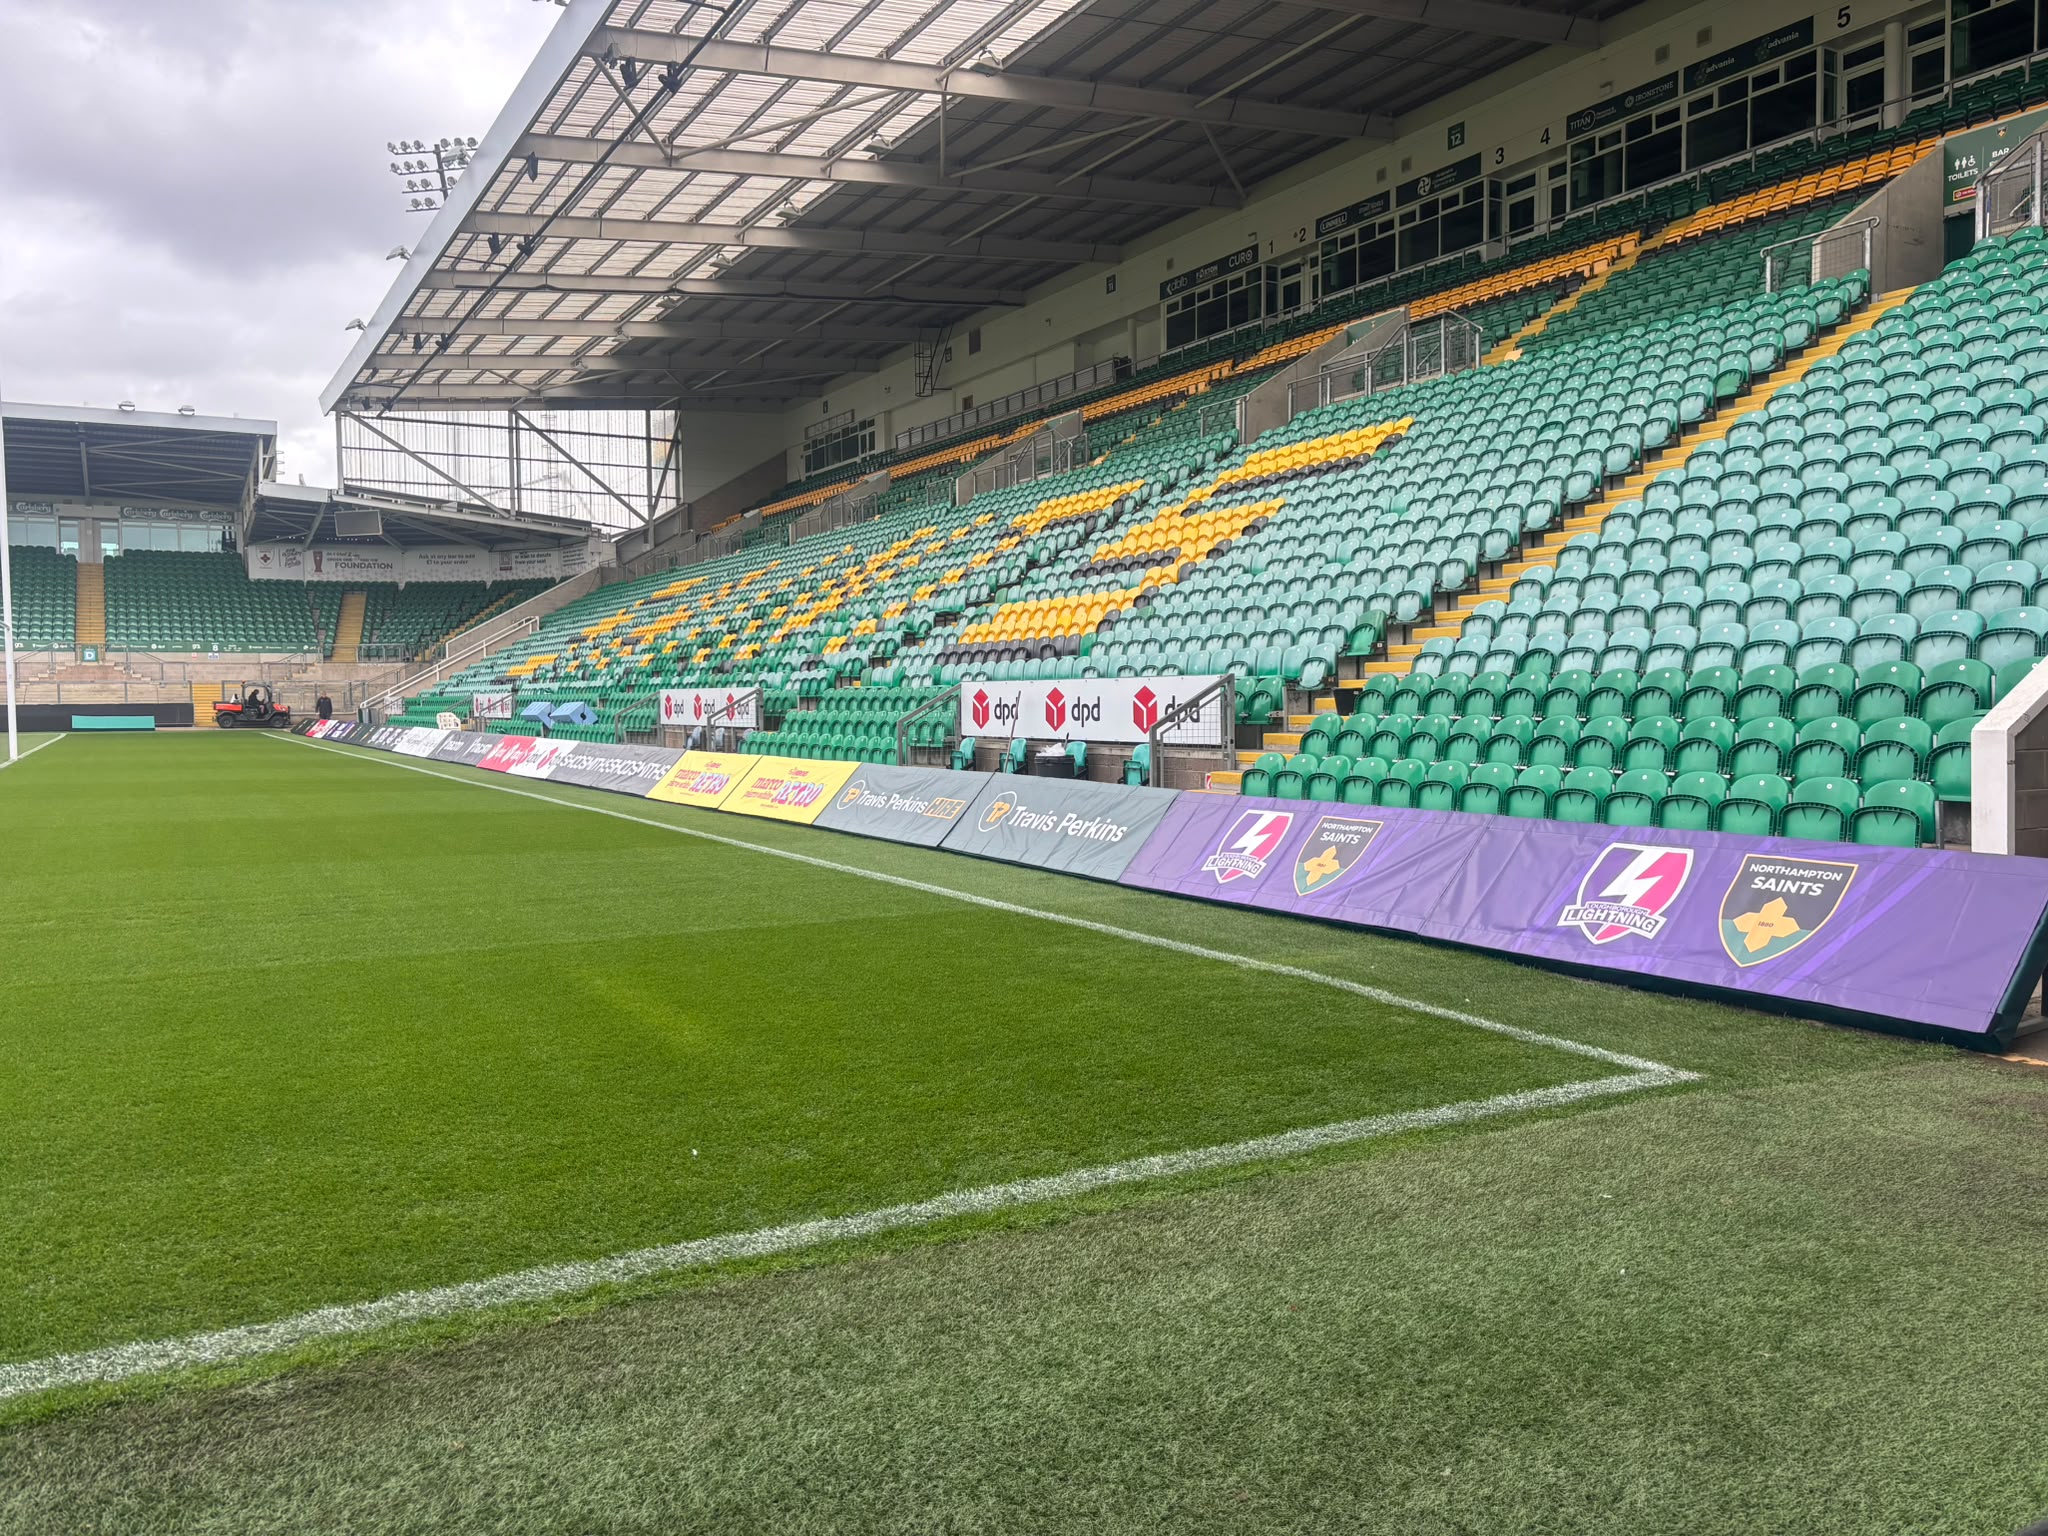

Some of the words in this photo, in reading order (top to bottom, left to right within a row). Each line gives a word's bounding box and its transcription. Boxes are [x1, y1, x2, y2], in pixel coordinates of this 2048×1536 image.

[1837, 6, 1851, 28] 5
[1767, 31, 1800, 49] advania
[1635, 81, 1674, 102] IRONSTONE
[1569, 115, 1591, 131] TITAN
[1450, 134, 1462, 147] 12
[1540, 128, 1551, 144] 4
[1495, 147, 1505, 165] 3
[1948, 168, 1978, 182] TOILETS
[1299, 228, 1306, 243] 2
[1269, 241, 1274, 254] 1
[1229, 250, 1253, 268] CURO
[16, 502, 50, 513] Carlsberg
[123, 507, 157, 518] Carlsberg
[159, 509, 193, 520] Carlsberg
[200, 511, 232, 523] Carlsberg
[335, 562, 393, 570] FOUNDATION
[85, 651, 94, 660] D
[994, 696, 1019, 726] dpd
[1071, 696, 1100, 728] dpd
[607, 757, 671, 781] SHOOSMITHS
[751, 776, 784, 791] marco
[771, 780, 825, 808] RETRO
[857, 788, 886, 809] Travis
[888, 793, 927, 815] Perkins
[985, 801, 1009, 824] TP
[1009, 804, 1057, 831] Travis
[1056, 812, 1127, 843] Perkins
[1321, 822, 1373, 834] NORTHAMPTON
[1320, 831, 1361, 845] SAINTS
[1210, 855, 1260, 875] LIGHTNING
[1749, 863, 1843, 882] NORTHAMPTON
[1751, 876, 1824, 897] SAINTS
[1586, 902, 1648, 916] LOUGHBOROUGH
[1566, 908, 1656, 932] LIGHTNING
[1757, 920, 1774, 929] 1880
